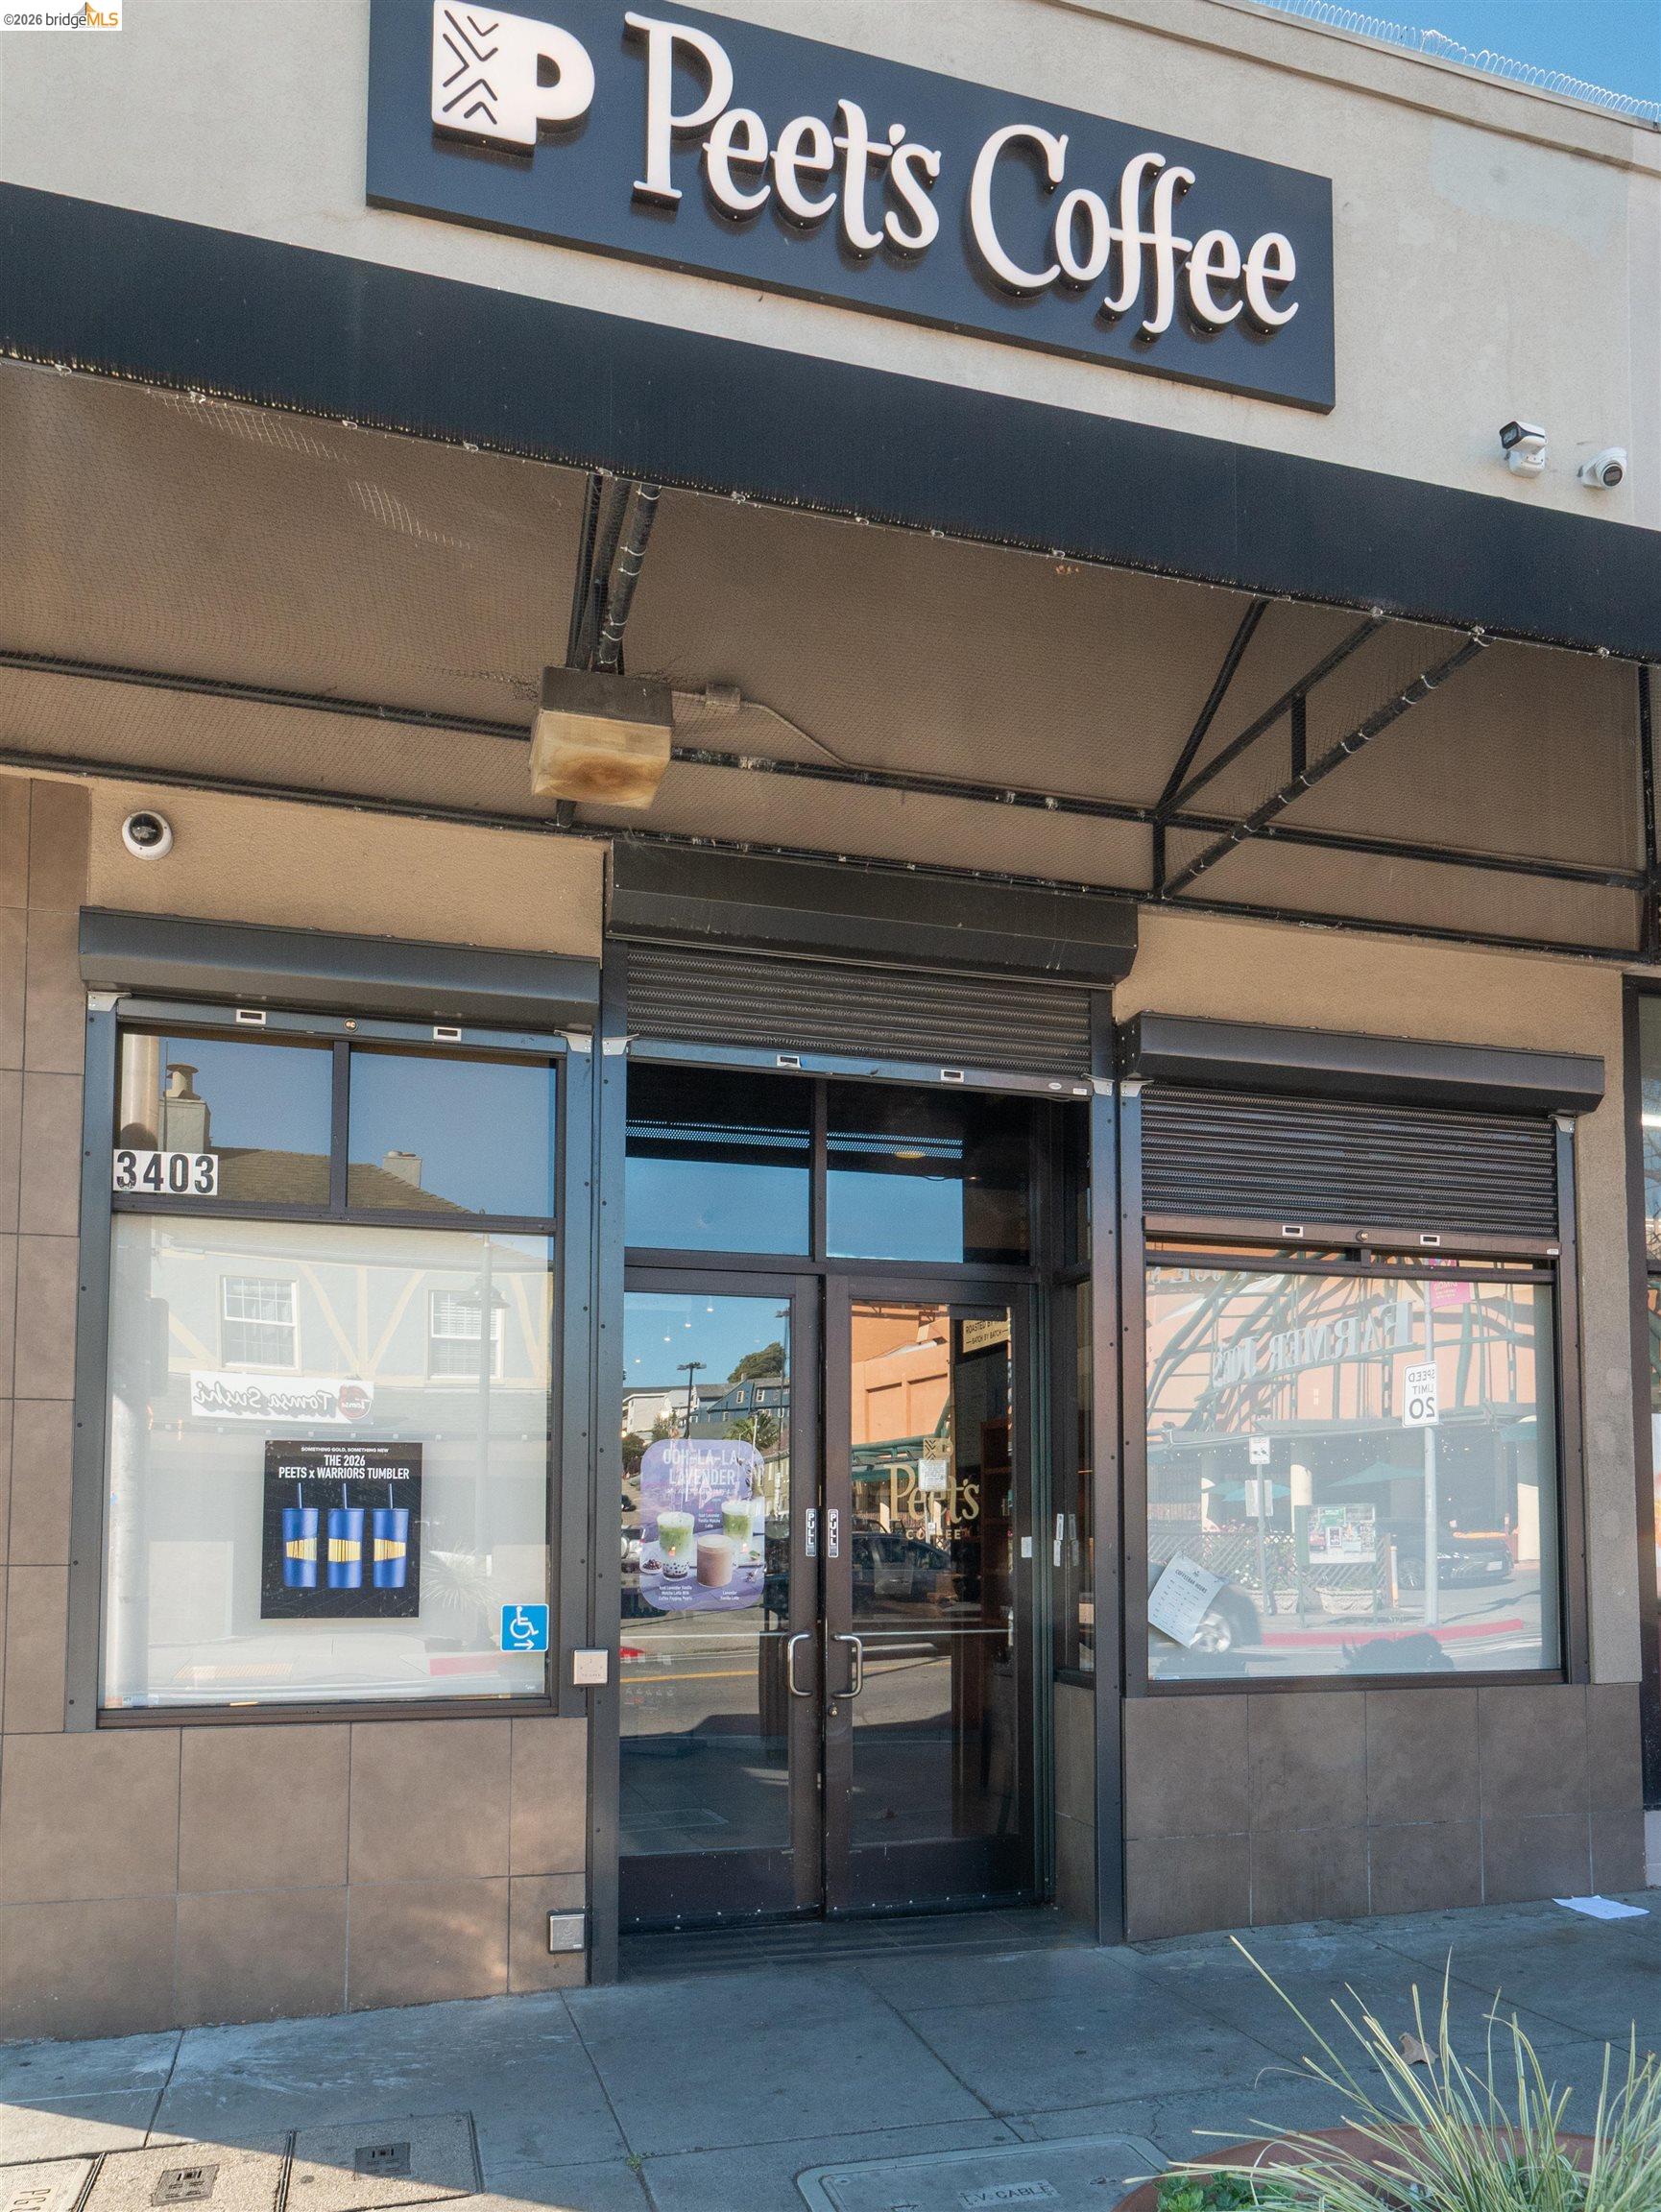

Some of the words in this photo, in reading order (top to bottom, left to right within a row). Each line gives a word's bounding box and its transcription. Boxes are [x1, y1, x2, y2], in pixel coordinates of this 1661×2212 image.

[625, 12, 941, 250] Peet's
[971, 124, 1299, 333] Coffee
[116, 1151, 214, 1193] 3403
[325, 1455, 341, 1466] THE
[343, 1455, 366, 1467] 2026
[278, 1467, 307, 1479] PEETS
[317, 1467, 365, 1479] WARRIORS
[367, 1468, 410, 1479] TUMBLER
[669, 1468, 735, 1486] LAVENDER
